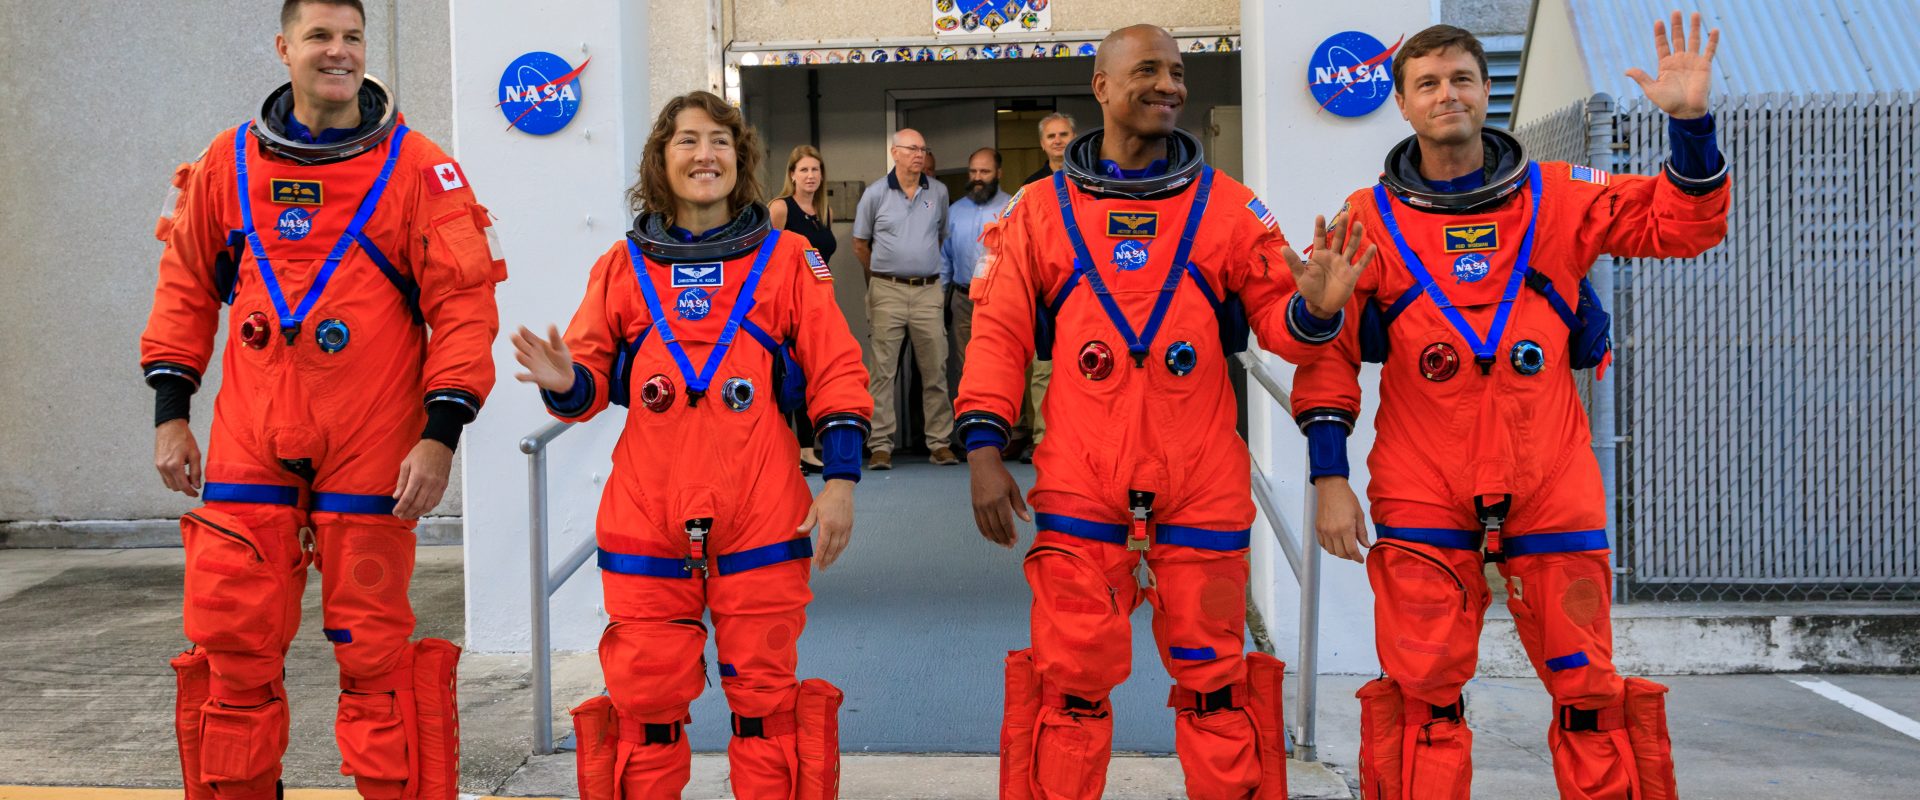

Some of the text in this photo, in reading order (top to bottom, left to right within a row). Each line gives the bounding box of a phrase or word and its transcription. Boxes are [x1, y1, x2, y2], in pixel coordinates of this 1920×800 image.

[1315, 63, 1390, 84] NASA
[505, 84, 577, 103] NASA
[280, 218, 309, 228] NASA
[1115, 249, 1147, 260] NASA
[1455, 261, 1488, 272] NASA
[679, 299, 709, 308] NASA
